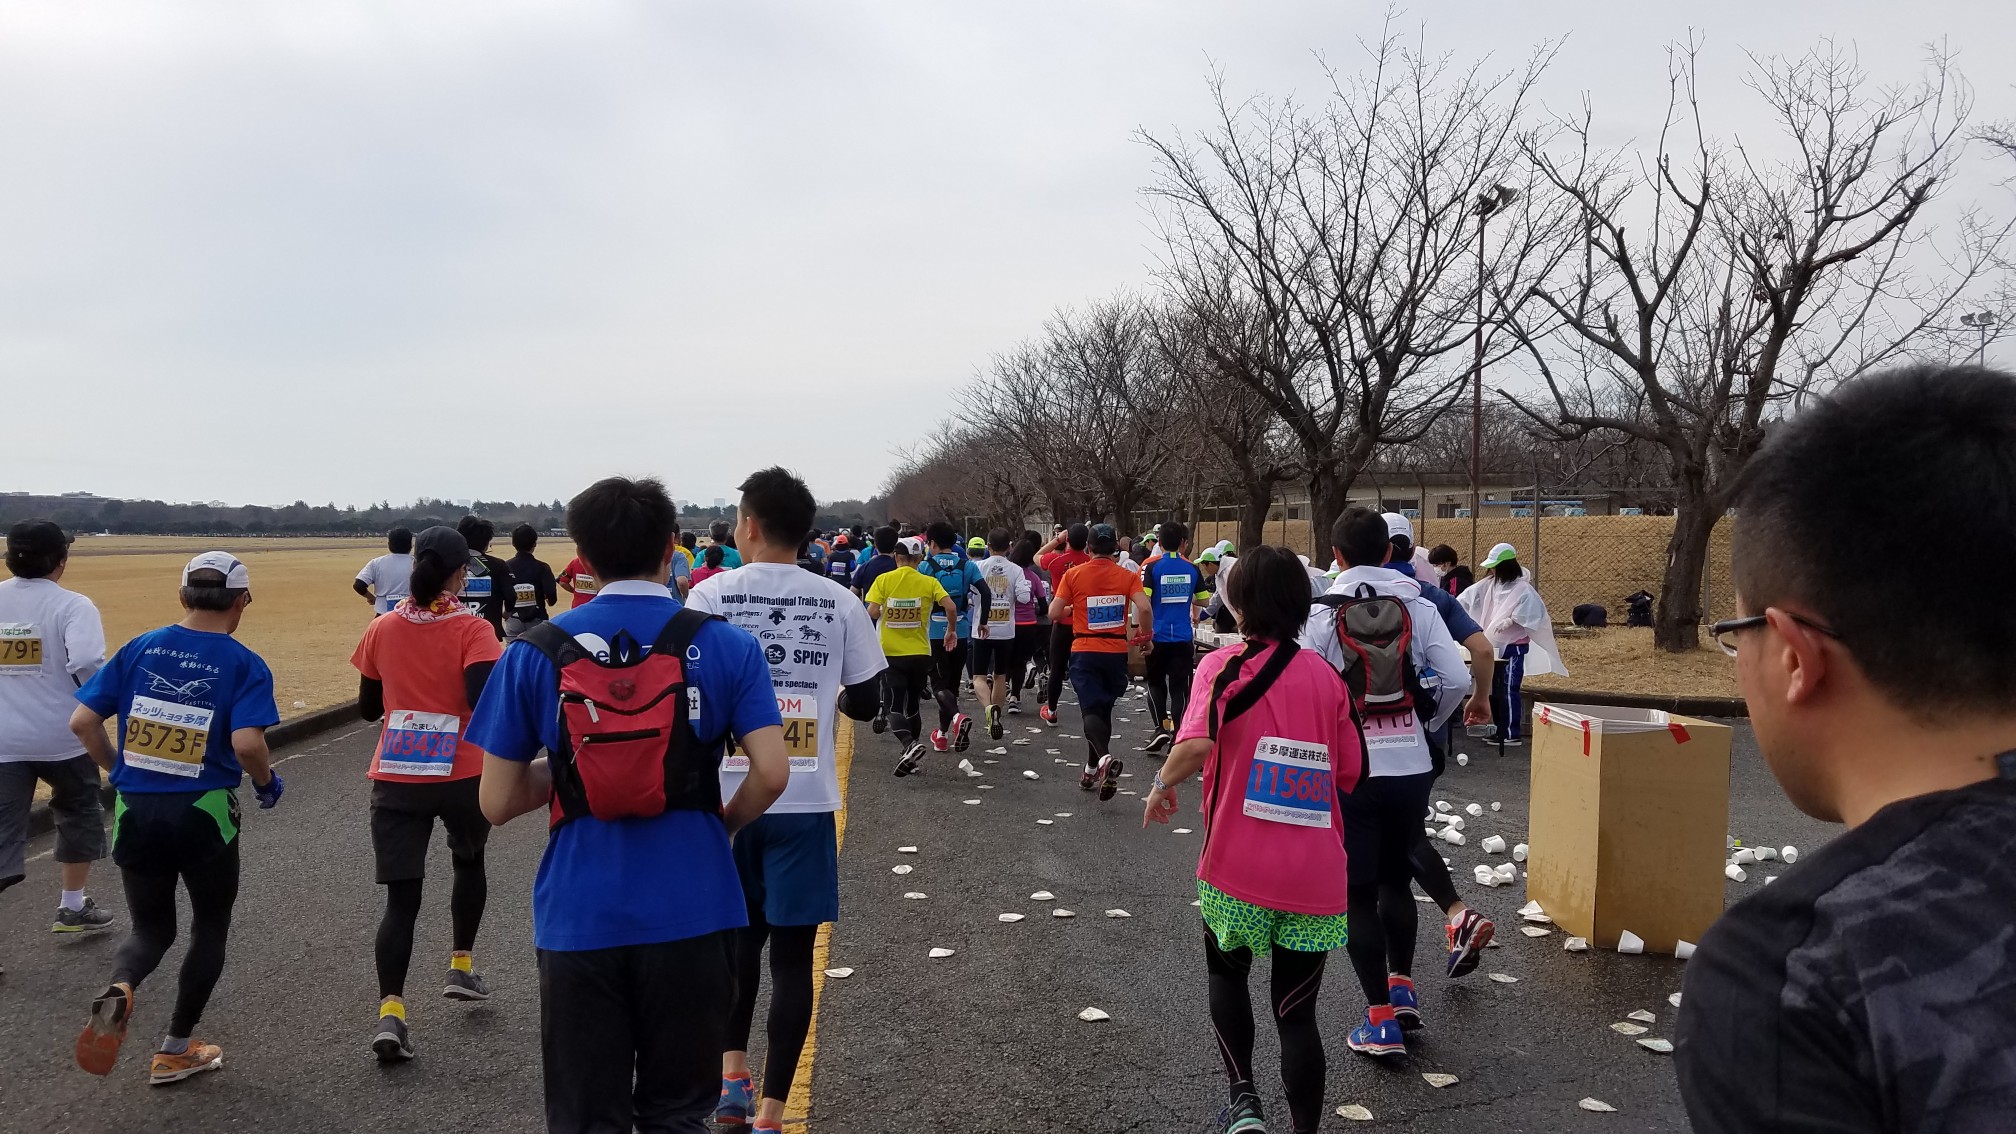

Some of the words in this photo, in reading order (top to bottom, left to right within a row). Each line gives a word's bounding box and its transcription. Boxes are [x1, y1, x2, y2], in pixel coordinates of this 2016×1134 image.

[721, 593, 748, 604] HAKUBA
[749, 594, 796, 606] International
[798, 596, 818, 607] Trails
[819, 598, 835, 609] 2014
[3, 640, 40, 659] 79F
[793, 649, 830, 667] SPICY
[134, 702, 209, 727] ネッツトヨタ多摩
[411, 722, 439, 731] たましん
[127, 718, 205, 756] 9573F
[385, 730, 455, 757] 10342G
